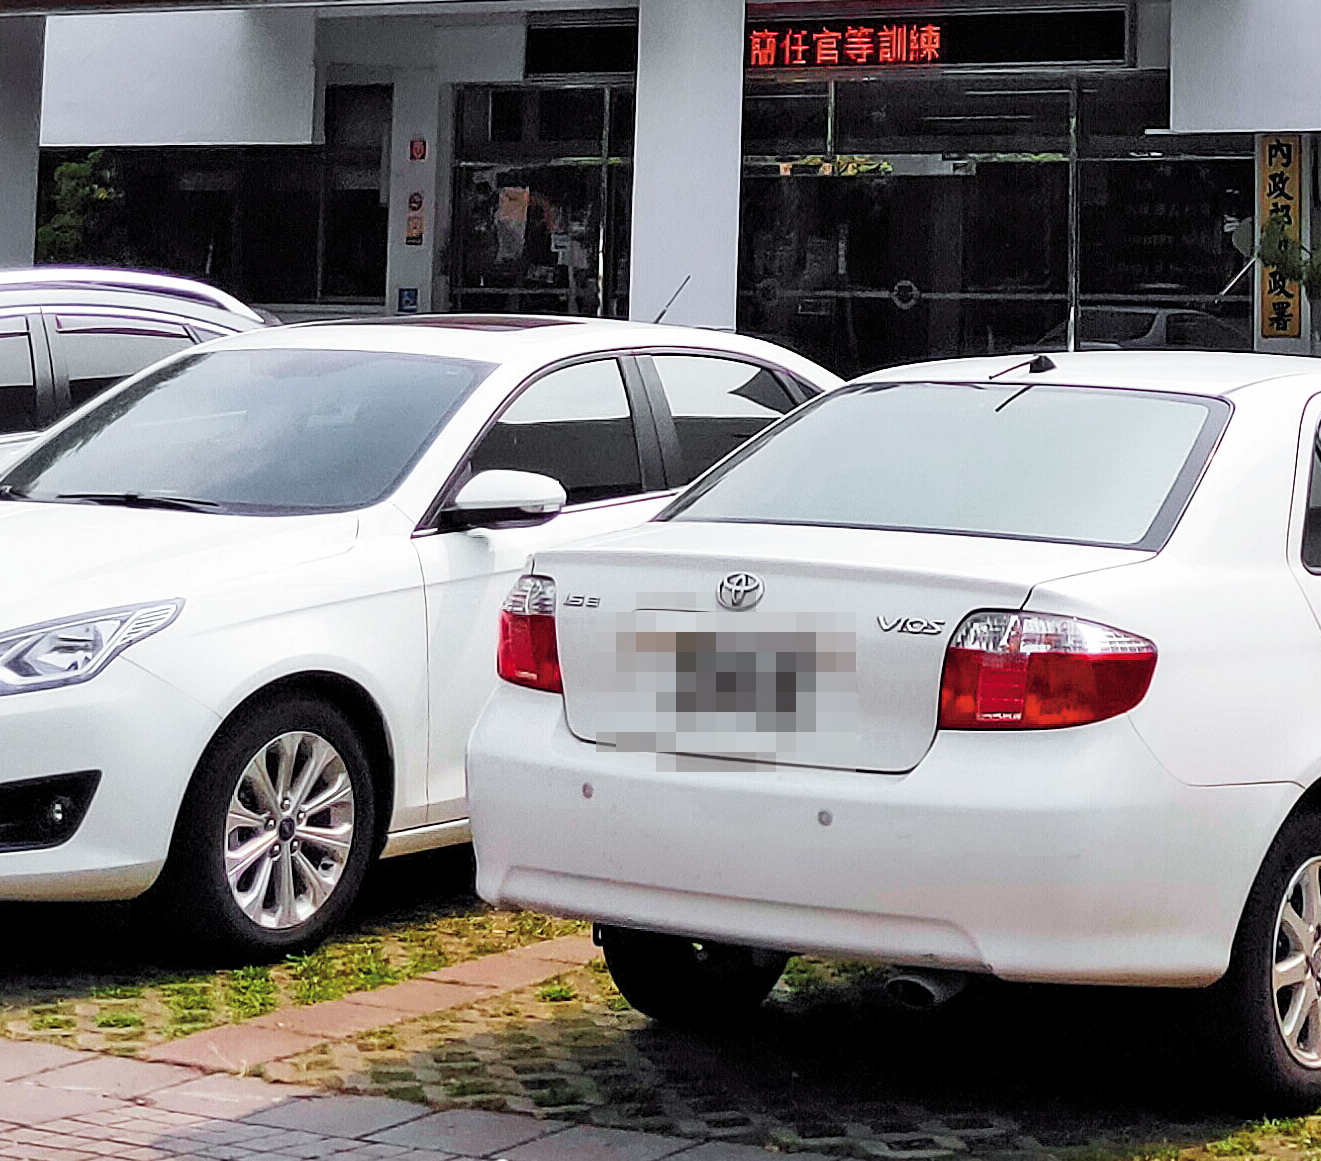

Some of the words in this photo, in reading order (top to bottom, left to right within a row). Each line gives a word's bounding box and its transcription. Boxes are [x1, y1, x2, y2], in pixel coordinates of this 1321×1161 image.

[750, 24, 941, 65] 簡任官等訓練
[1267, 139, 1294, 331] 內政部政署
[876, 614, 946, 635] VIOS
